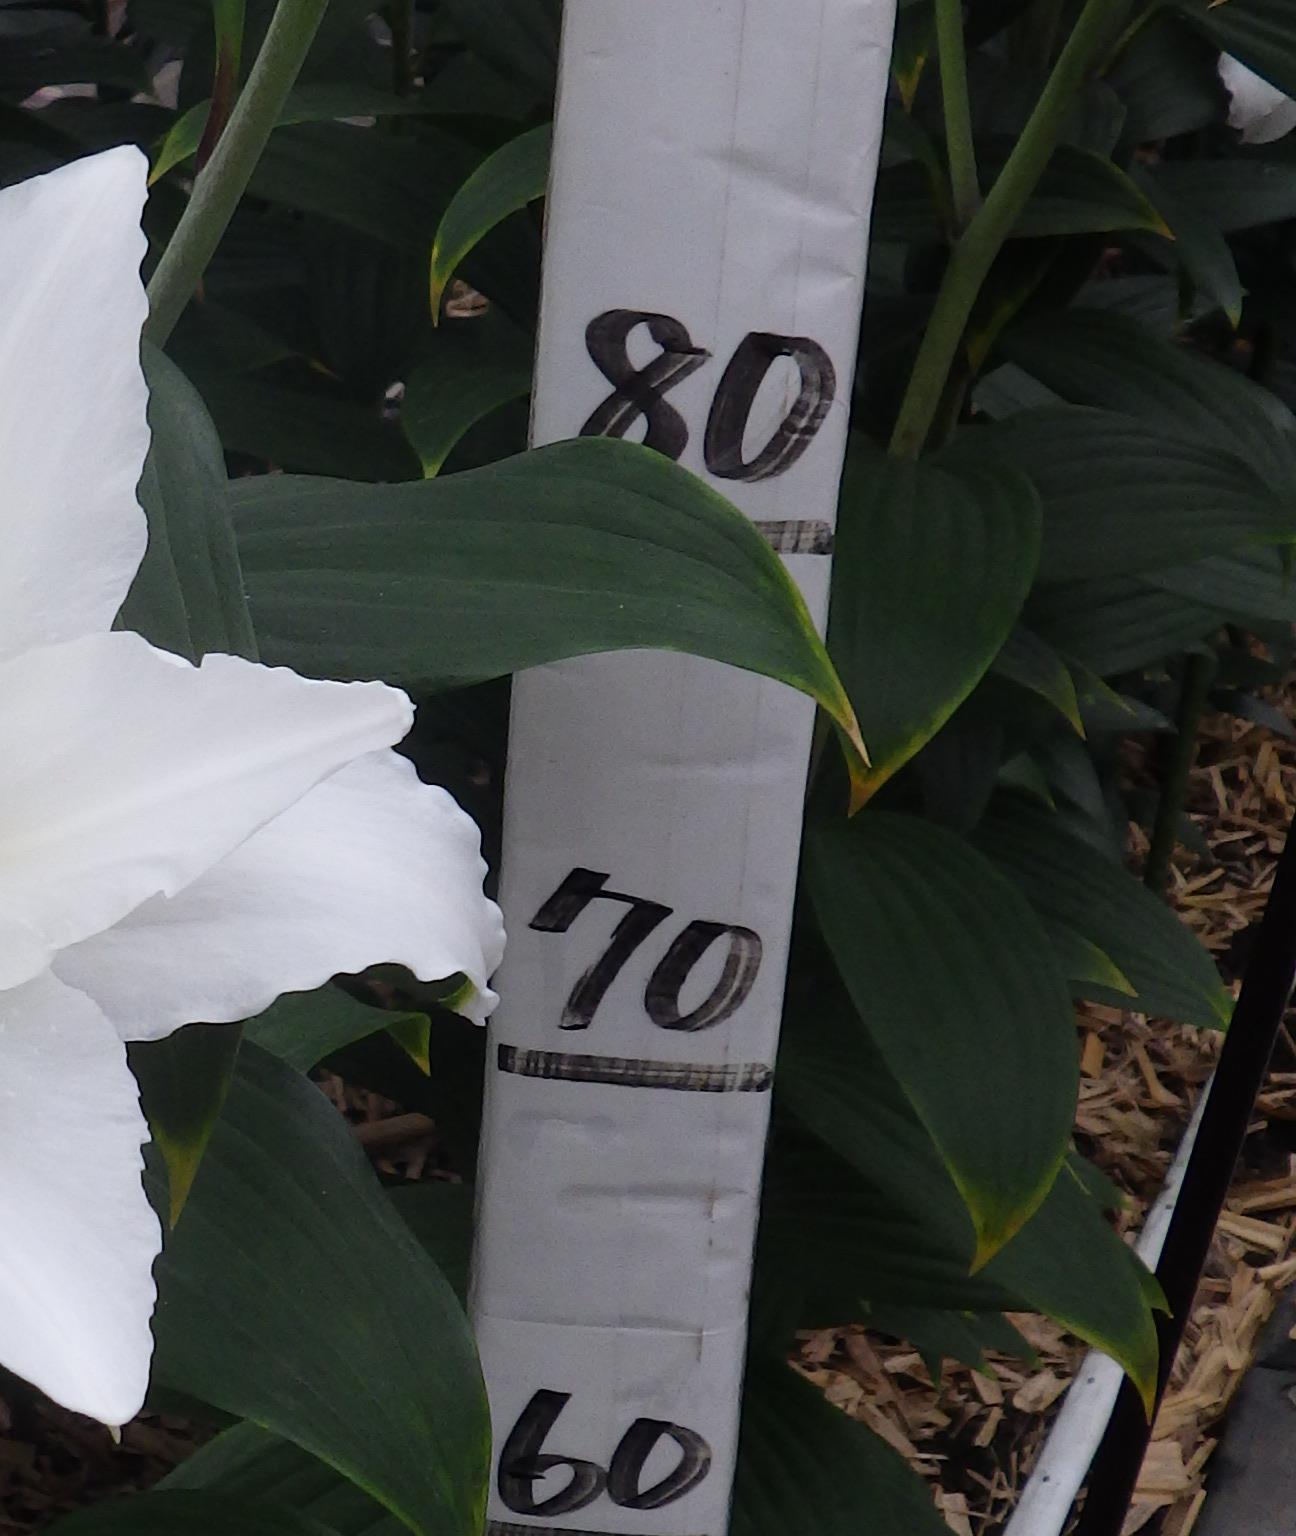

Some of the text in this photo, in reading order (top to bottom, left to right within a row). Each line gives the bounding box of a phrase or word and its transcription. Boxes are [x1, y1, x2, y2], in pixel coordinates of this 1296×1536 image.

[578, 308, 836, 483] 80
[528, 867, 763, 1032] 70
[497, 1388, 712, 1517] 60
